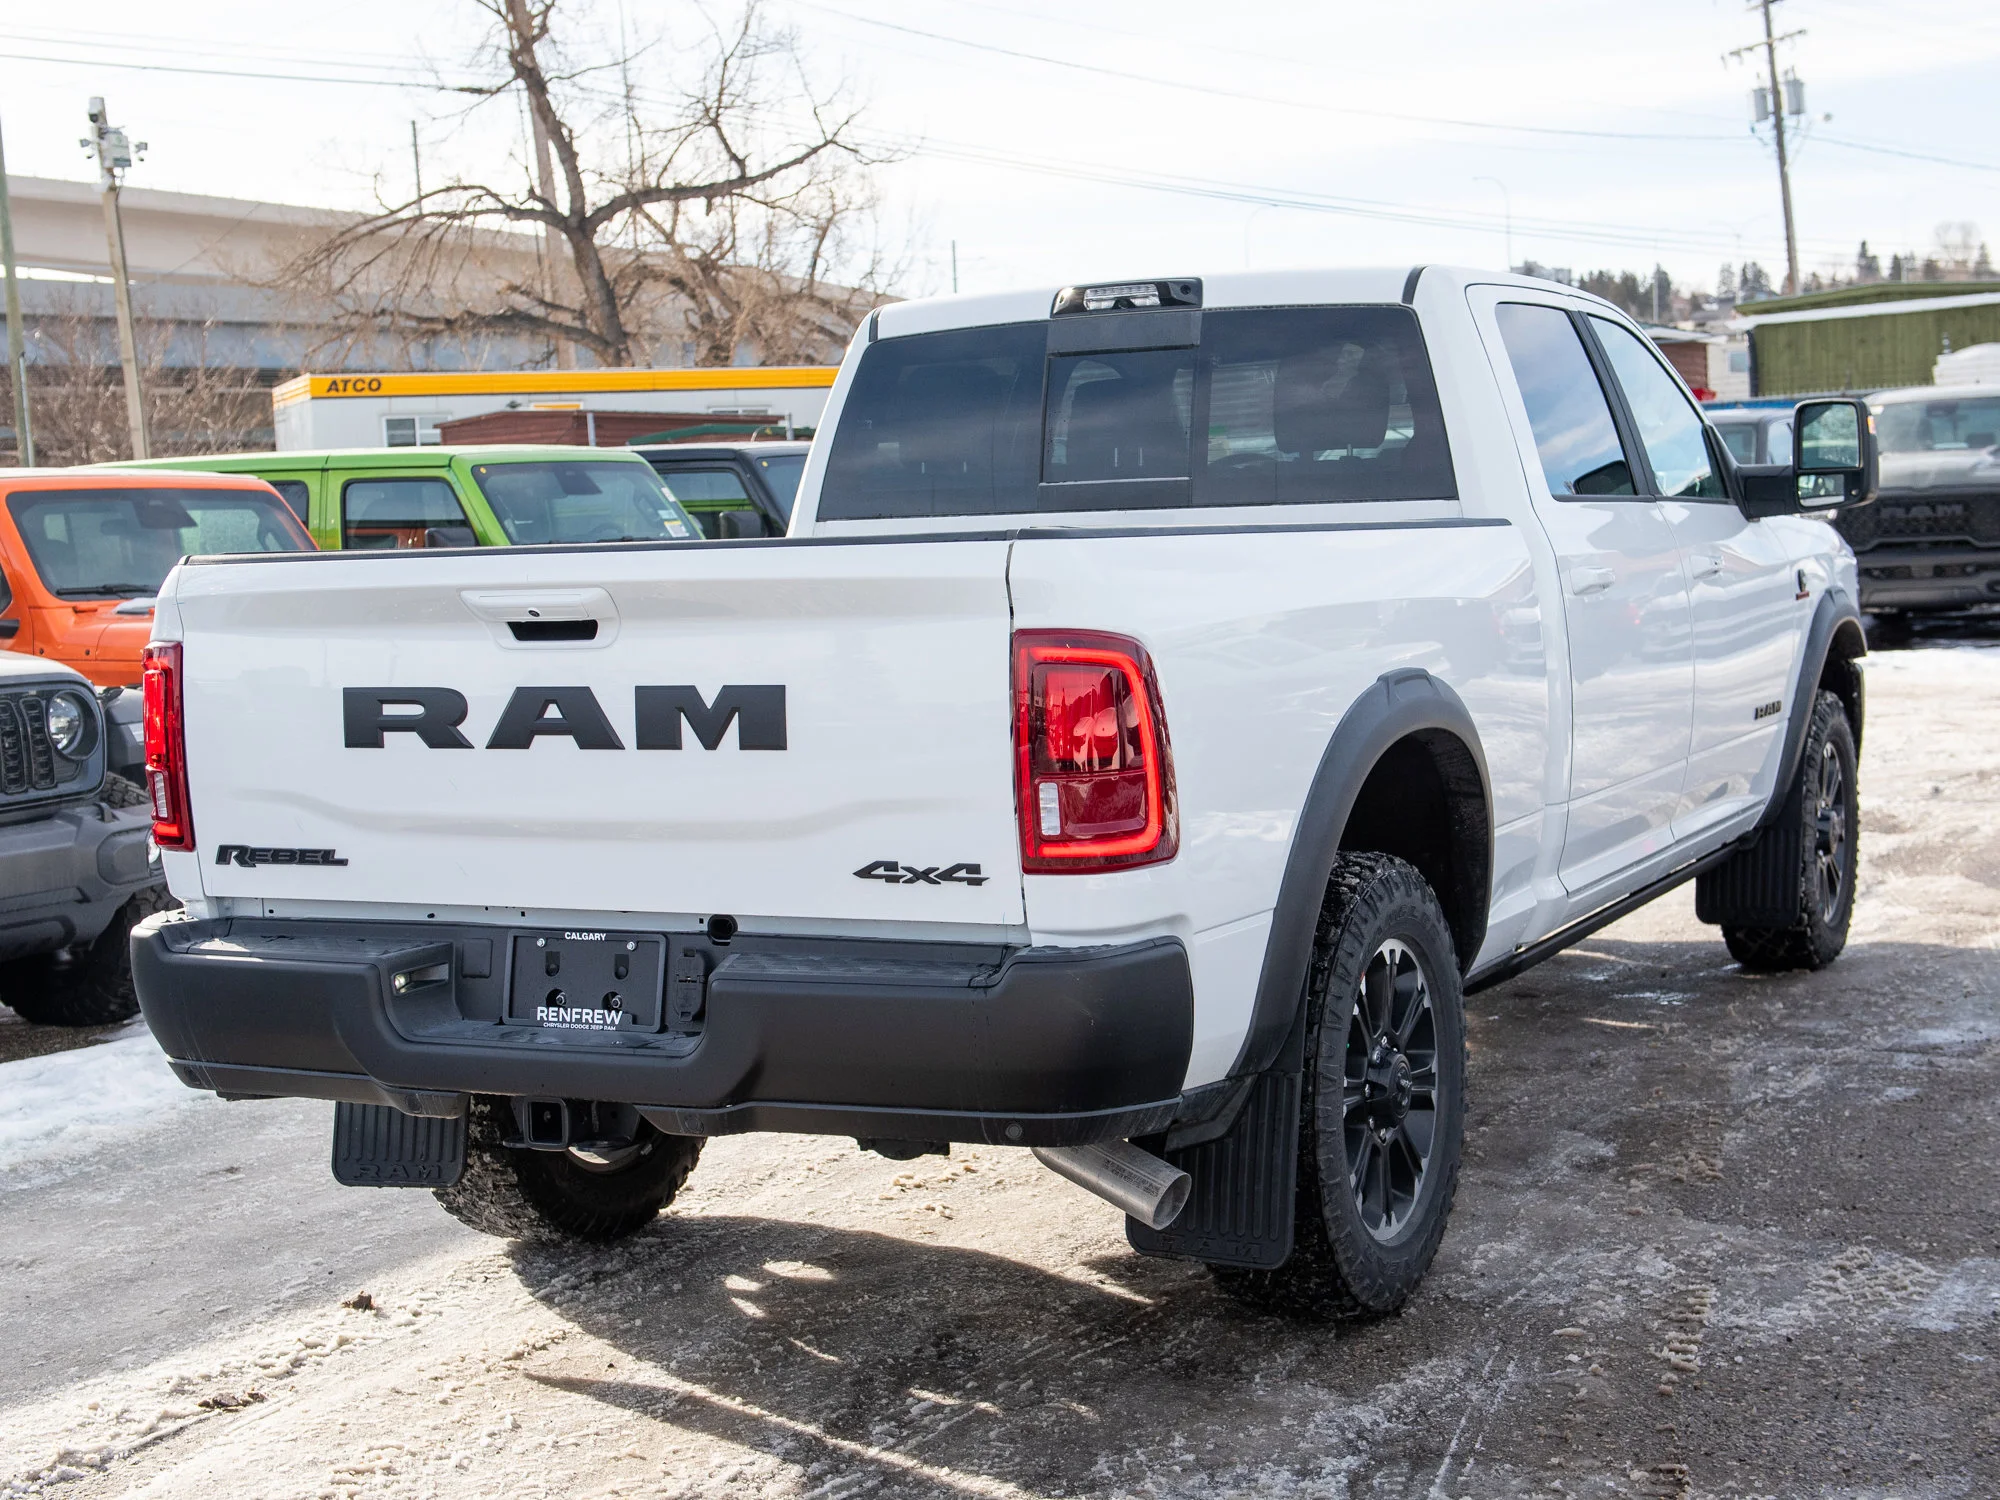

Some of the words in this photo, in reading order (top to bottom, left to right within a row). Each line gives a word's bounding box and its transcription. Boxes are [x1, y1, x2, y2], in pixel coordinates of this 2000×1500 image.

[326, 377, 382, 393] ATCO
[342, 684, 788, 751] RAM
[215, 844, 349, 868] REBEL
[852, 860, 991, 886] 4x4
[564, 931, 607, 941] CALGARY
[536, 1006, 623, 1025] RENFREW
[353, 1162, 443, 1180] RAM
